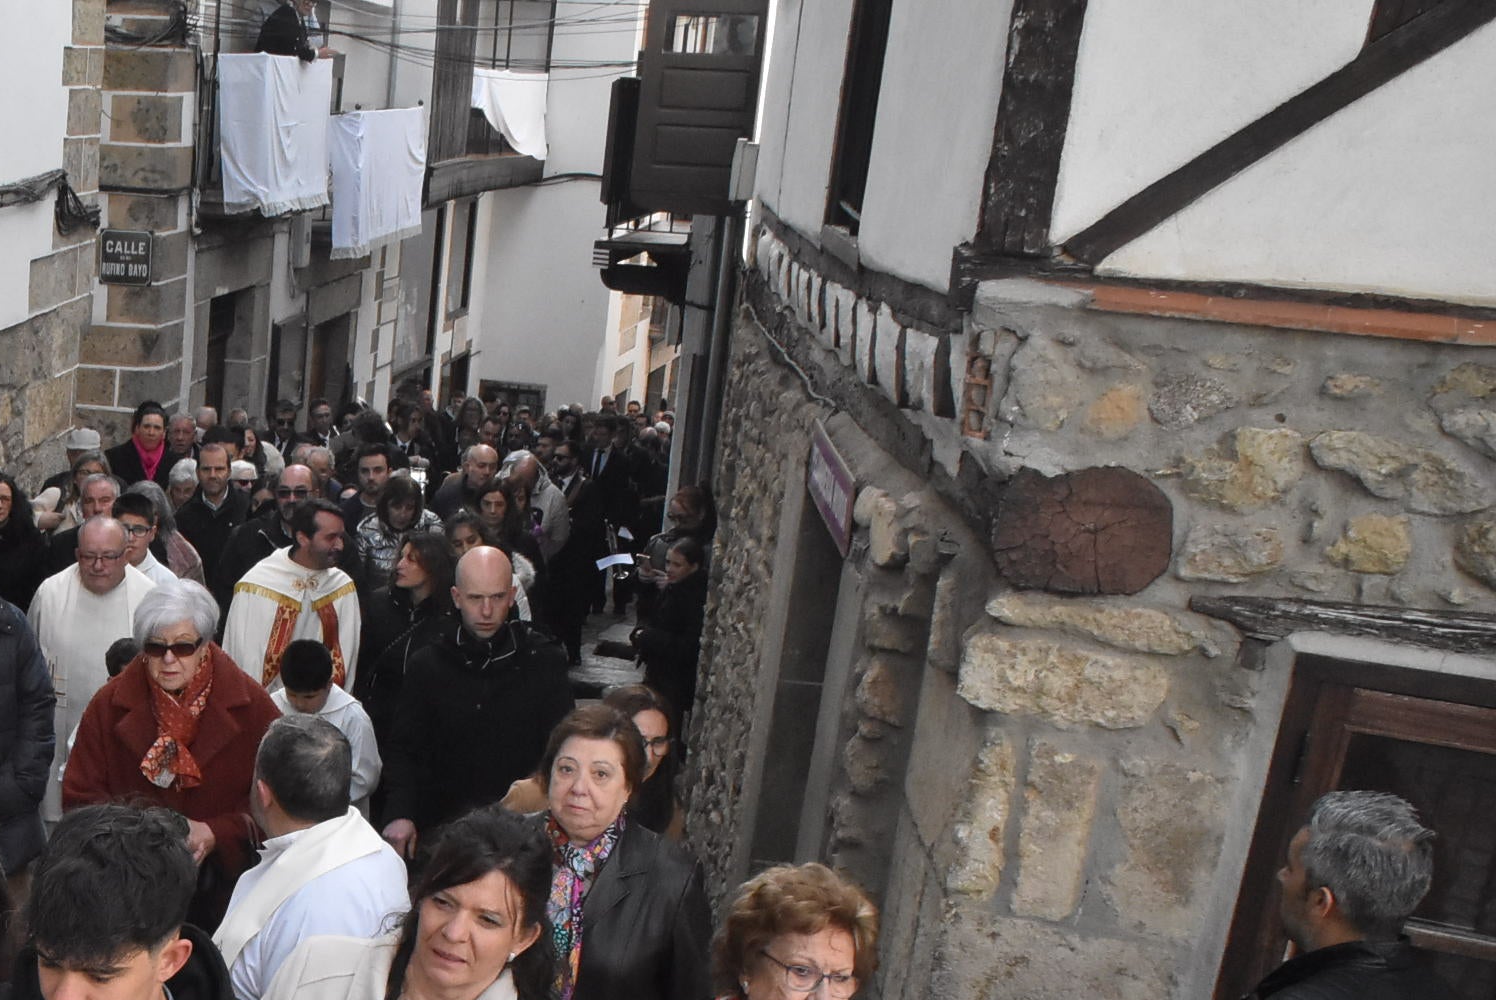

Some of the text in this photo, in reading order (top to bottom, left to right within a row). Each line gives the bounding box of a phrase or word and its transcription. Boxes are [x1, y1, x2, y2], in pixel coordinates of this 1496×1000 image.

[106, 240, 146, 254] CALLE
[102, 262, 148, 277] RUFINO BAYO
